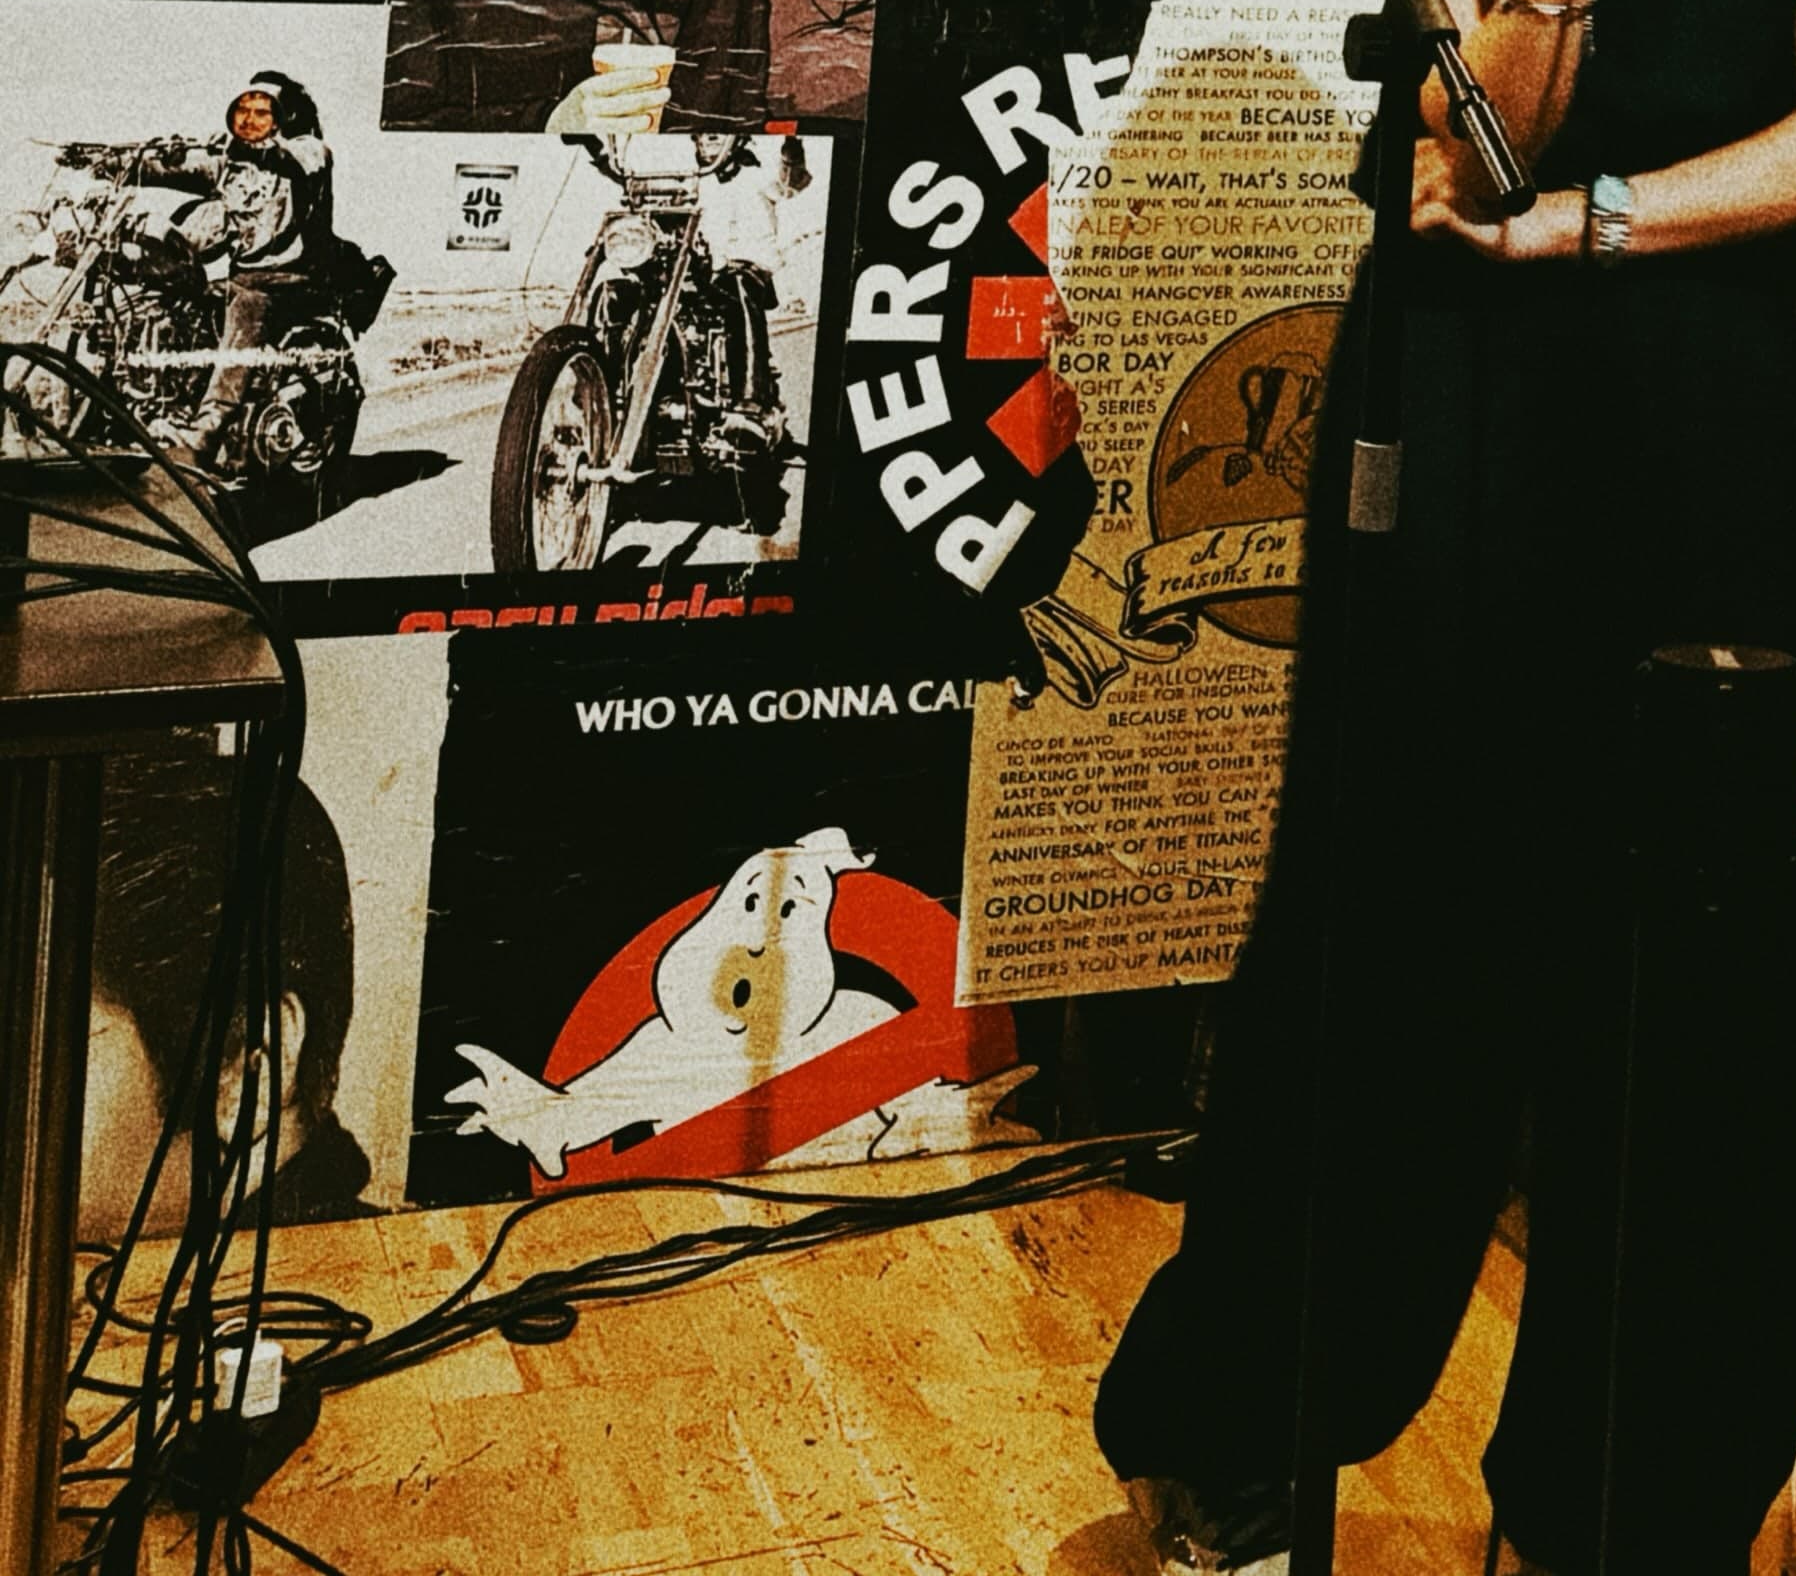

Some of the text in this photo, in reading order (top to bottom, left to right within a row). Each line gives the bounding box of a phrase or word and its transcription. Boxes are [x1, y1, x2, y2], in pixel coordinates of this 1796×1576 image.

[1160, 4, 1301, 22] REALLY NEED A
[1155, 44, 1274, 63] THOMPSON'S
[1186, 88, 1294, 102] BREAKFAST YOU
[1240, 107, 1377, 127] BECAUSE YO
[1200, 130, 1261, 143] BECAUSE
[1304, 131, 1331, 143] HAS
[1051, 163, 1350, 194] /20 WAIT, THAT'S SOM
[1174, 215, 1373, 236] YOUR FAVORITE
[1092, 246, 1298, 261] FRIDGE WORKING
[1120, 265, 1335, 277] UP WITH SIGNIFICANT
[1132, 285, 1346, 301] HANGOVER AWARENESS
[1132, 309, 1238, 326] ENGAGED
[1094, 333, 1208, 347] TO LAS VEGAS
[1124, 352, 1174, 372] DAY
[1097, 400, 1158, 415] SERIES
[1123, 421, 1150, 433] DAY
[1104, 438, 1145, 451] SLEEP
[1093, 456, 1136, 474] DAY
[1225, 525, 1287, 569] few
[1158, 562, 1287, 596] reasons to
[1133, 664, 1267, 688] HALLOWEEN
[1106, 683, 1276, 705] CURE FOR INSOMNIA
[574, 678, 977, 736] WHO YA GONNA CAL
[1108, 703, 1234, 727] BECAUSE YOU
[1072, 734, 1114, 748] MAYO
[1030, 747, 1134, 766] IMPROVE YOUR
[1000, 759, 1200, 785] BREAKING UP WITH YOUR
[1003, 785, 1068, 801] LAST DAY
[993, 788, 1259, 819] MAKES YOU THINK YOU CAN
[1104, 809, 1252, 834] FOR THE
[988, 829, 1262, 865] ANNIVERSARY OF THE TITANIC
[992, 873, 1046, 889] WINTER
[984, 878, 1236, 920] GROUNDHOG DAY
[985, 926, 1210, 958] REDUCES THE HEART
[1000, 958, 1116, 983] CHEERS YOU
